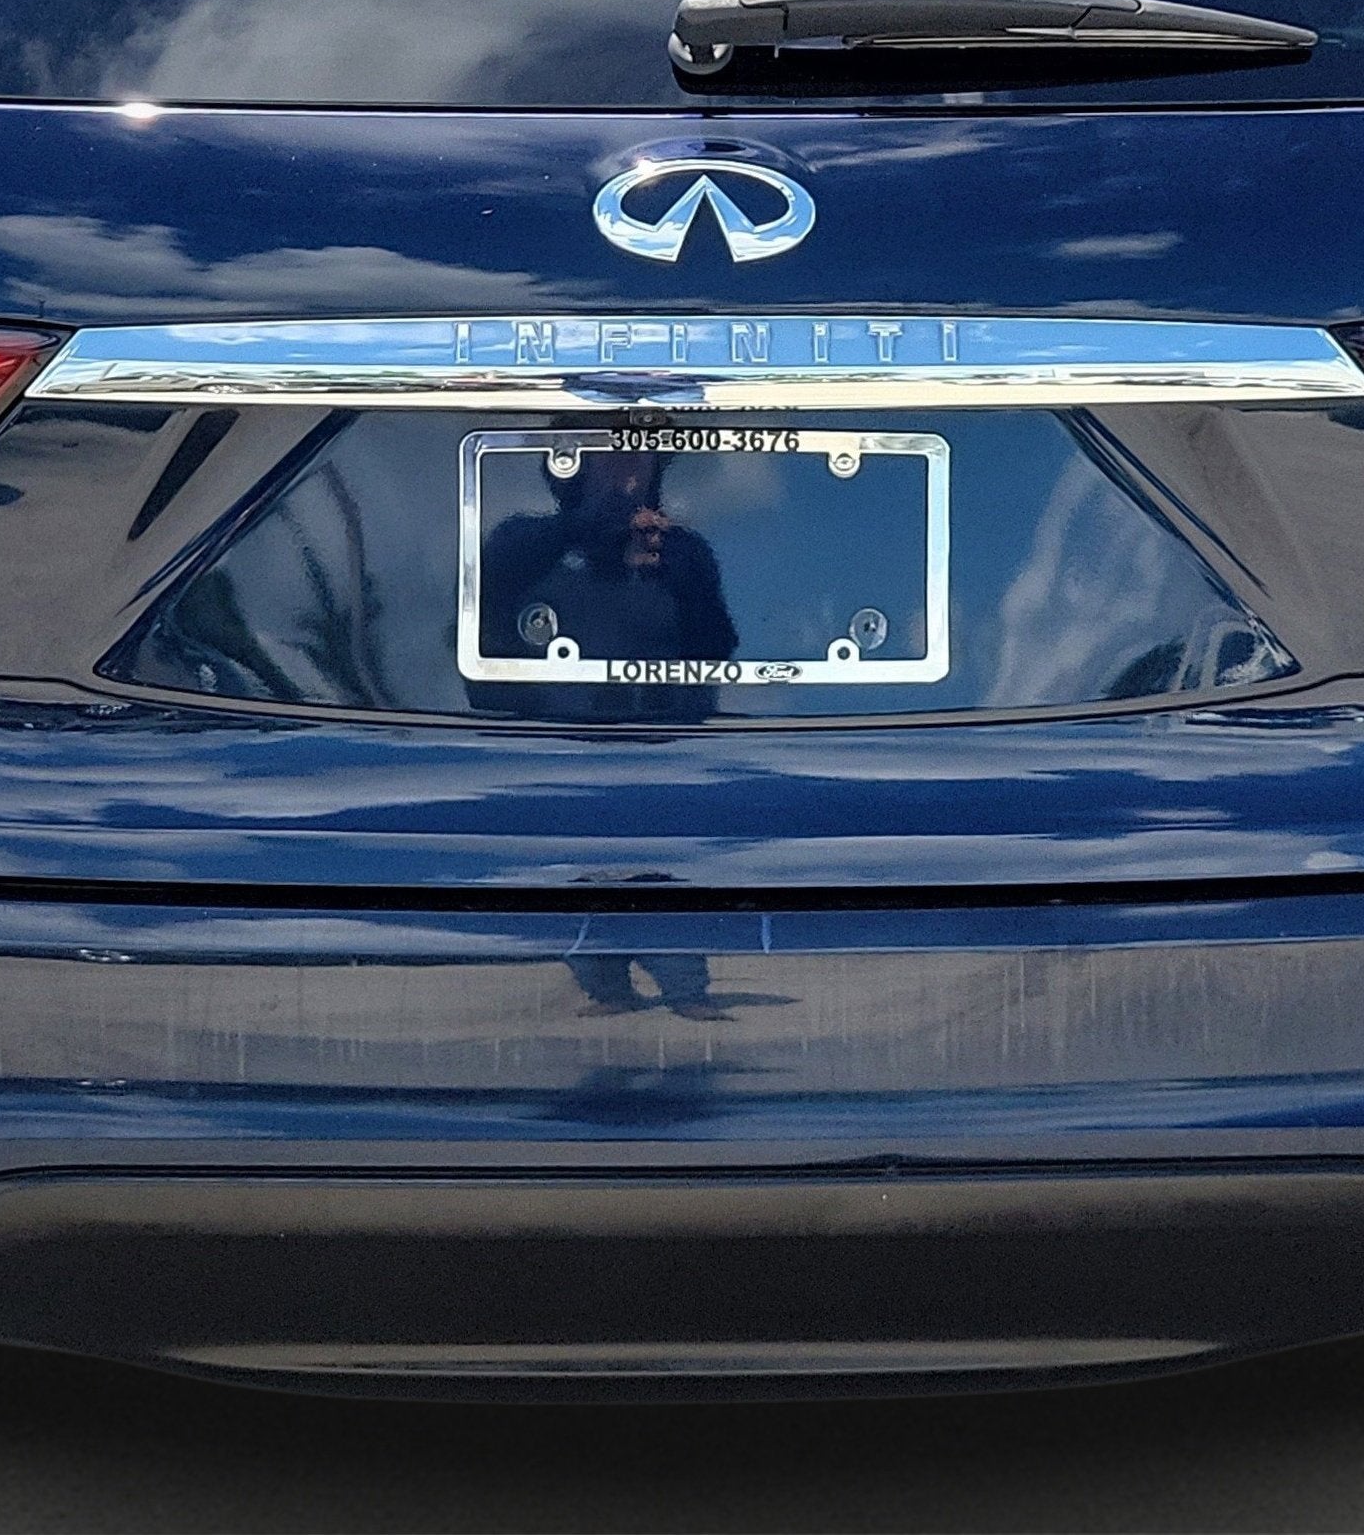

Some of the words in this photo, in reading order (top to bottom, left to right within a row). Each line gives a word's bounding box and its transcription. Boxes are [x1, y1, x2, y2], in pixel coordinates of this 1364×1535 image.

[452, 320, 962, 365] INFINITI
[610, 430, 800, 452] 305-600-3676
[606, 660, 743, 683] LORENZO
